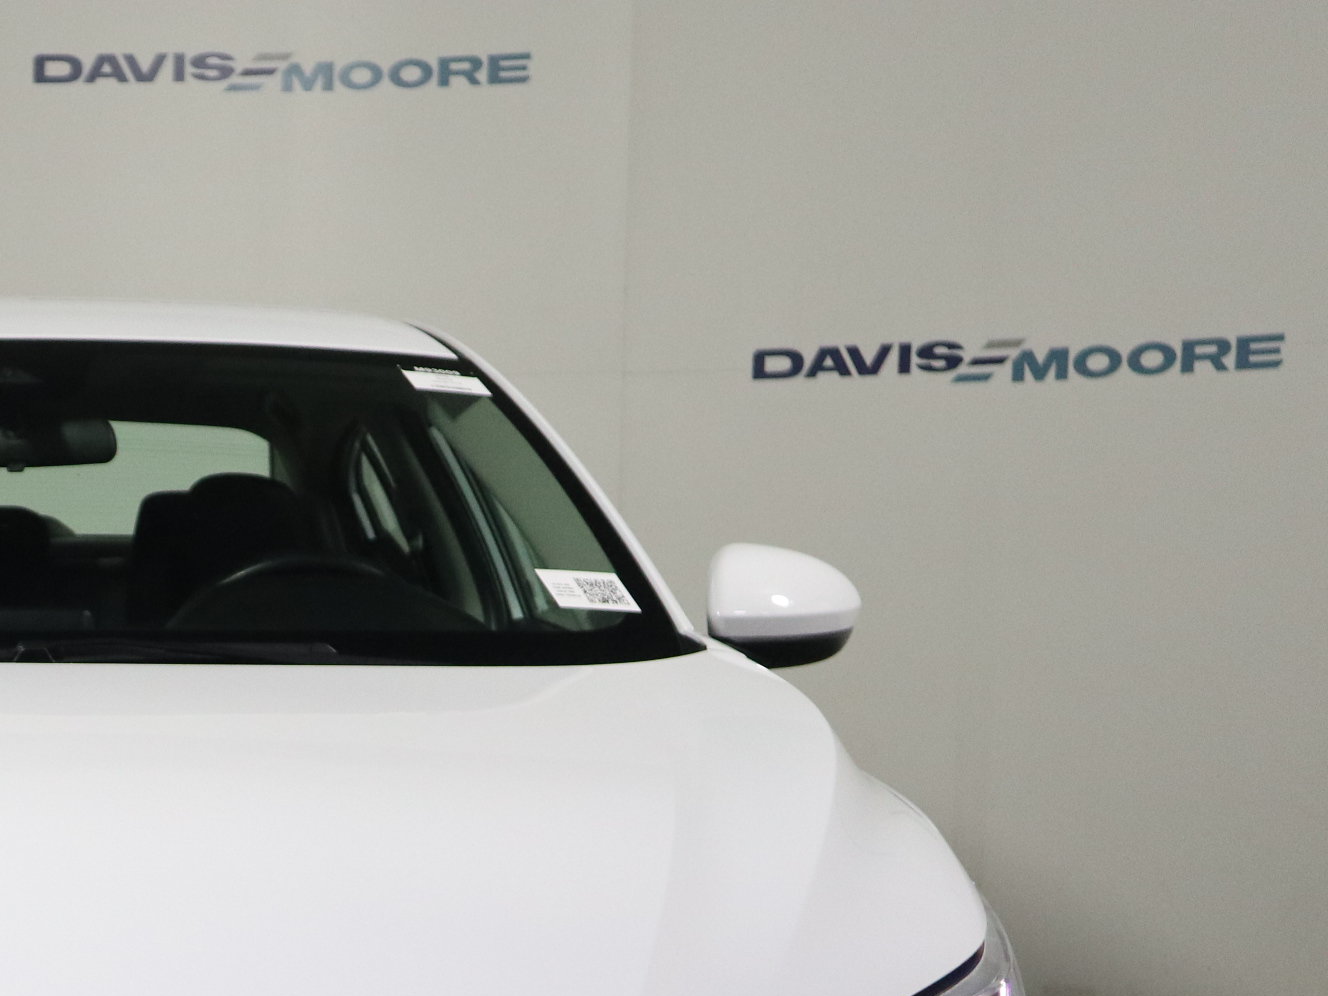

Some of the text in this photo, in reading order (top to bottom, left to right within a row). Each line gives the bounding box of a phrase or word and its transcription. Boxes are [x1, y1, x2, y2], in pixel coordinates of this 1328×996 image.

[33, 52, 531, 92] DAVIS MOORE
[752, 333, 1285, 382] DAVIS MOORE
